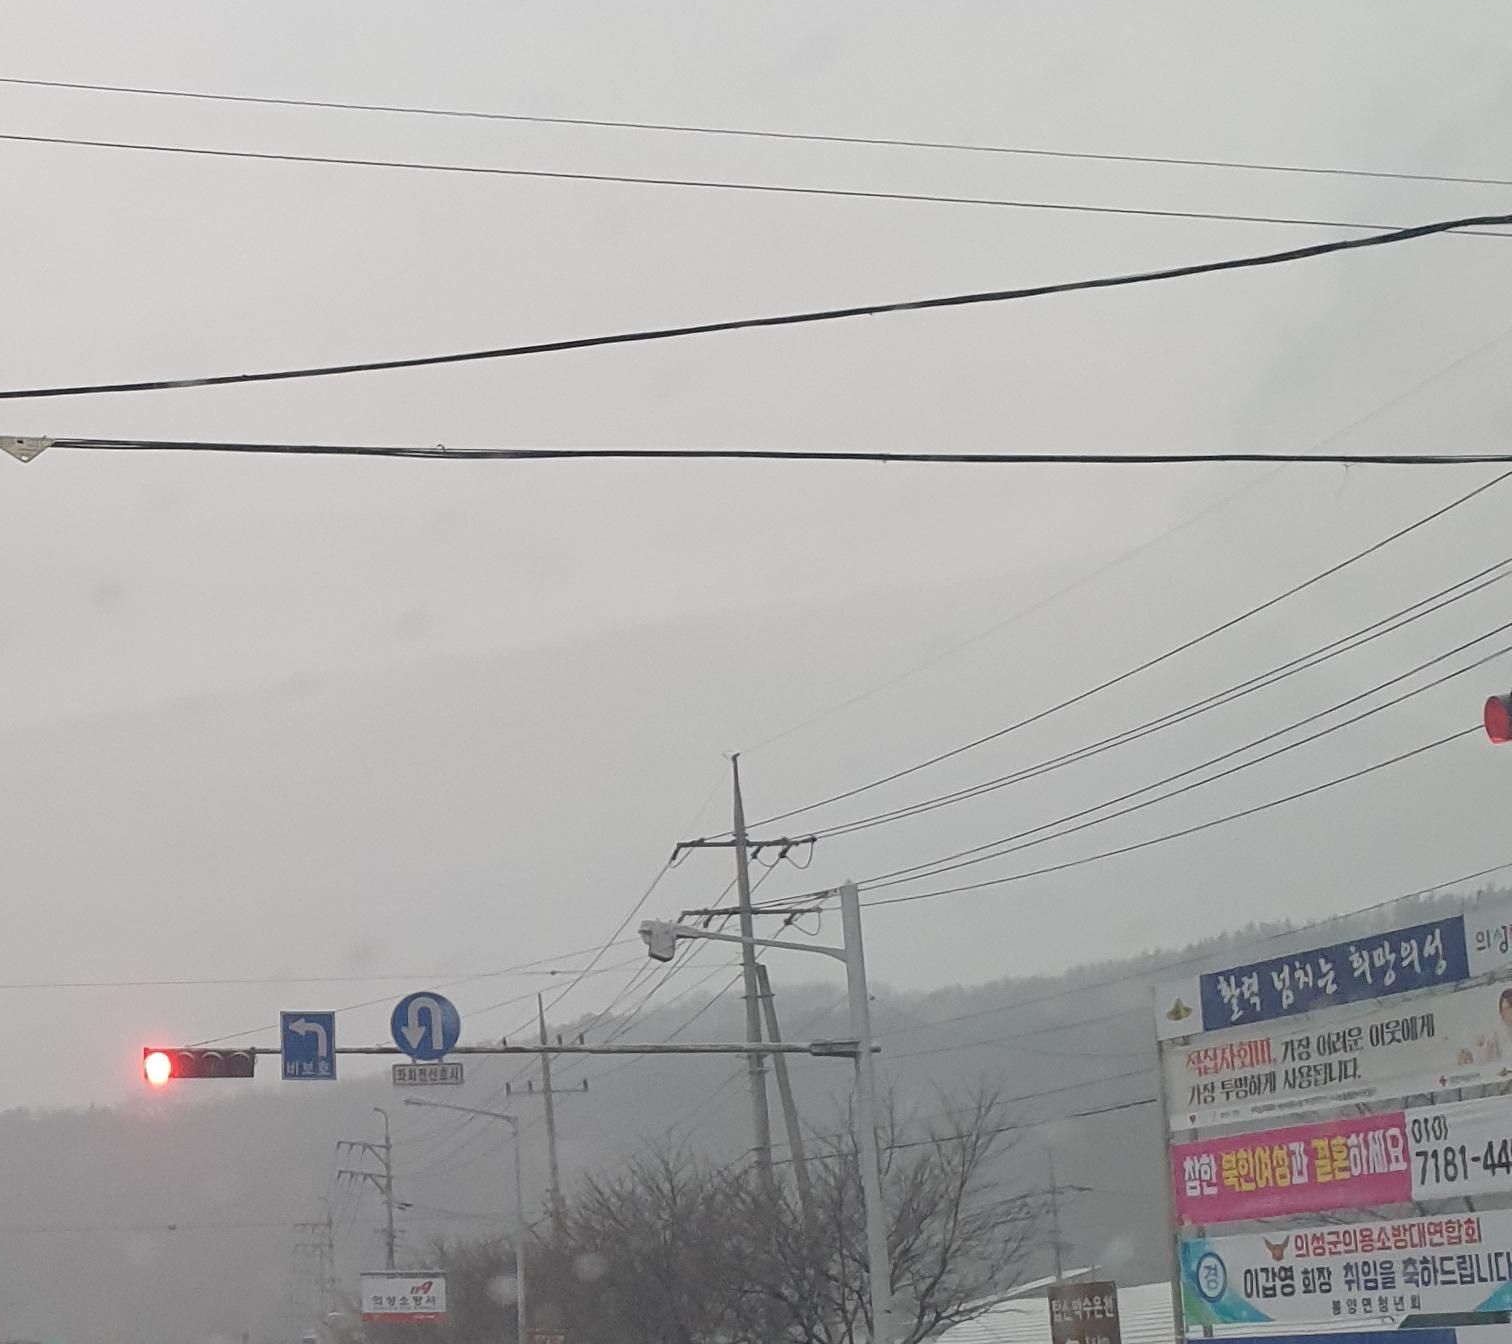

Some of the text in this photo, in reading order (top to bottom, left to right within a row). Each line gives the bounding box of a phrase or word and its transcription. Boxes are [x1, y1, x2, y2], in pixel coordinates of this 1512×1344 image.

[1217, 972, 1260, 1021] 활력
[1272, 958, 1337, 1009] 넘치는
[1282, 1036, 1312, 1062] 가장
[1317, 1027, 1363, 1057] 어려운
[1369, 1013, 1435, 1047] 이웃에게
[287, 1061, 331, 1076] 비보호
[1221, 1071, 1277, 1101] 투명하게
[1183, 1127, 1408, 1197] 참한 북한여성과 결혼하세요
[1416, 1139, 1512, 1185] 7181-44
[1294, 1217, 1482, 1258] 의성군의용소방대연합회
[1244, 1265, 1296, 1298] 이갑영
[1301, 1267, 1333, 1294] 회장
[1343, 1260, 1396, 1292] 취임을
[372, 1295, 436, 1306] 의성소방서
